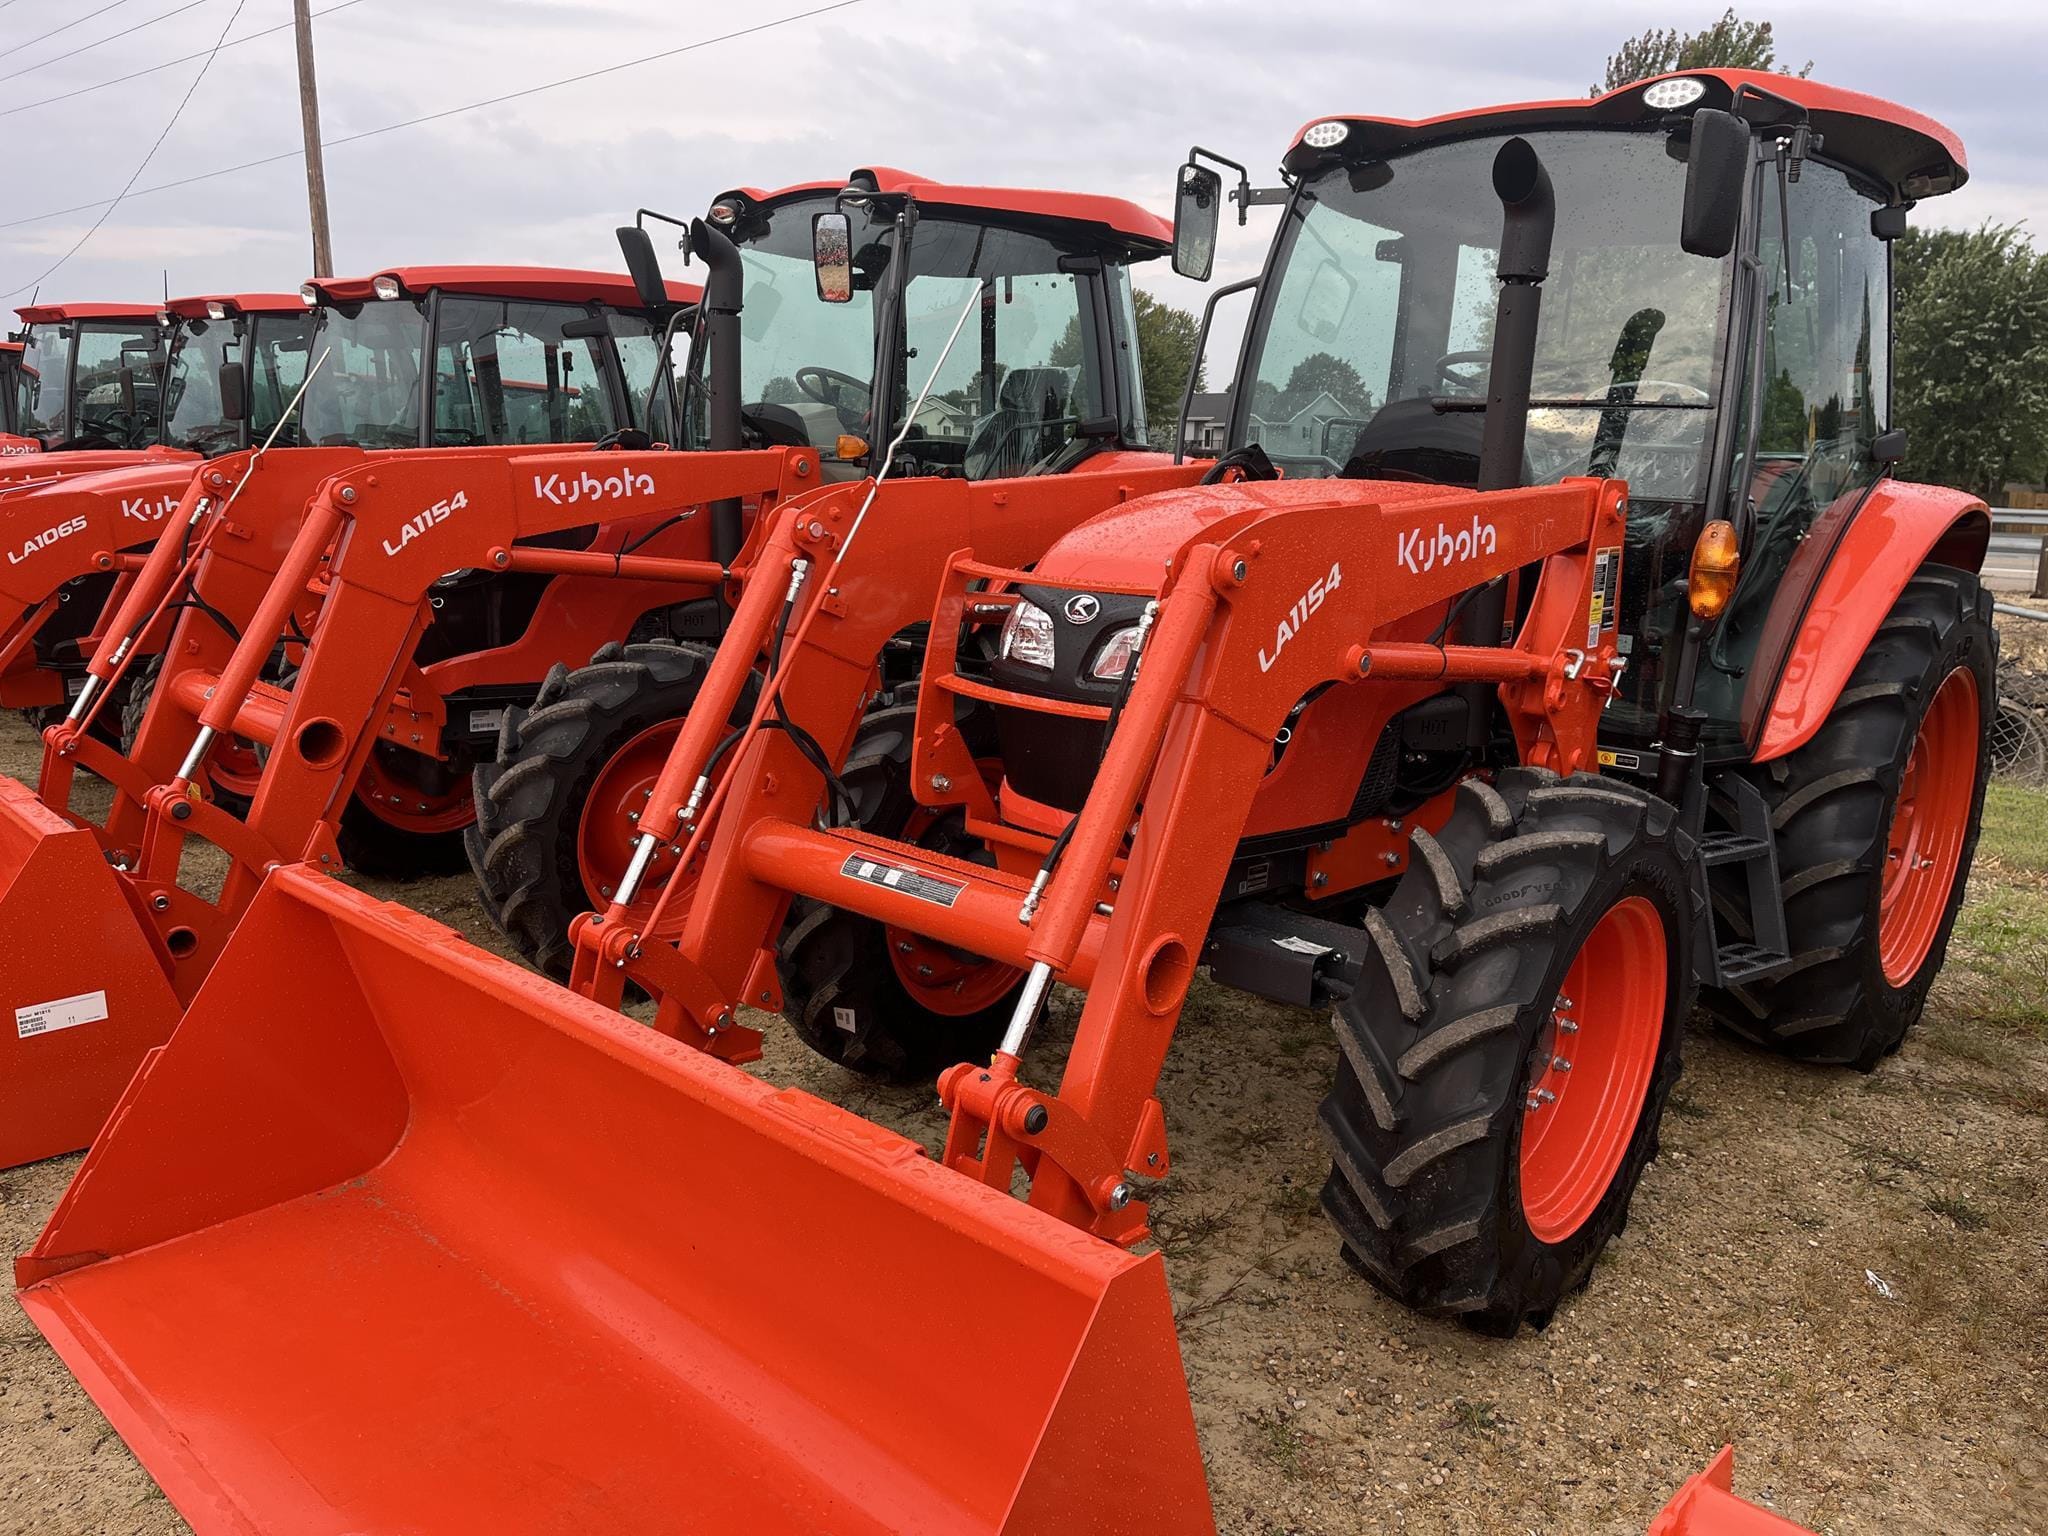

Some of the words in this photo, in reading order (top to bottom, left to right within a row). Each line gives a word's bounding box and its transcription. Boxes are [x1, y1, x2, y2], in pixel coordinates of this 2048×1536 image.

[0, 444, 40, 456] ubota
[534, 467, 656, 505] Kubota
[121, 495, 181, 522] Kub
[382, 490, 469, 557] LA1154
[7, 514, 88, 565] LA1065
[1397, 515, 1497, 575] Kubota
[683, 615, 705, 626] HOT
[1257, 562, 1342, 674] LA1154
[1420, 719, 1449, 736] HOT
[1485, 881, 1570, 908] GOODYEA
